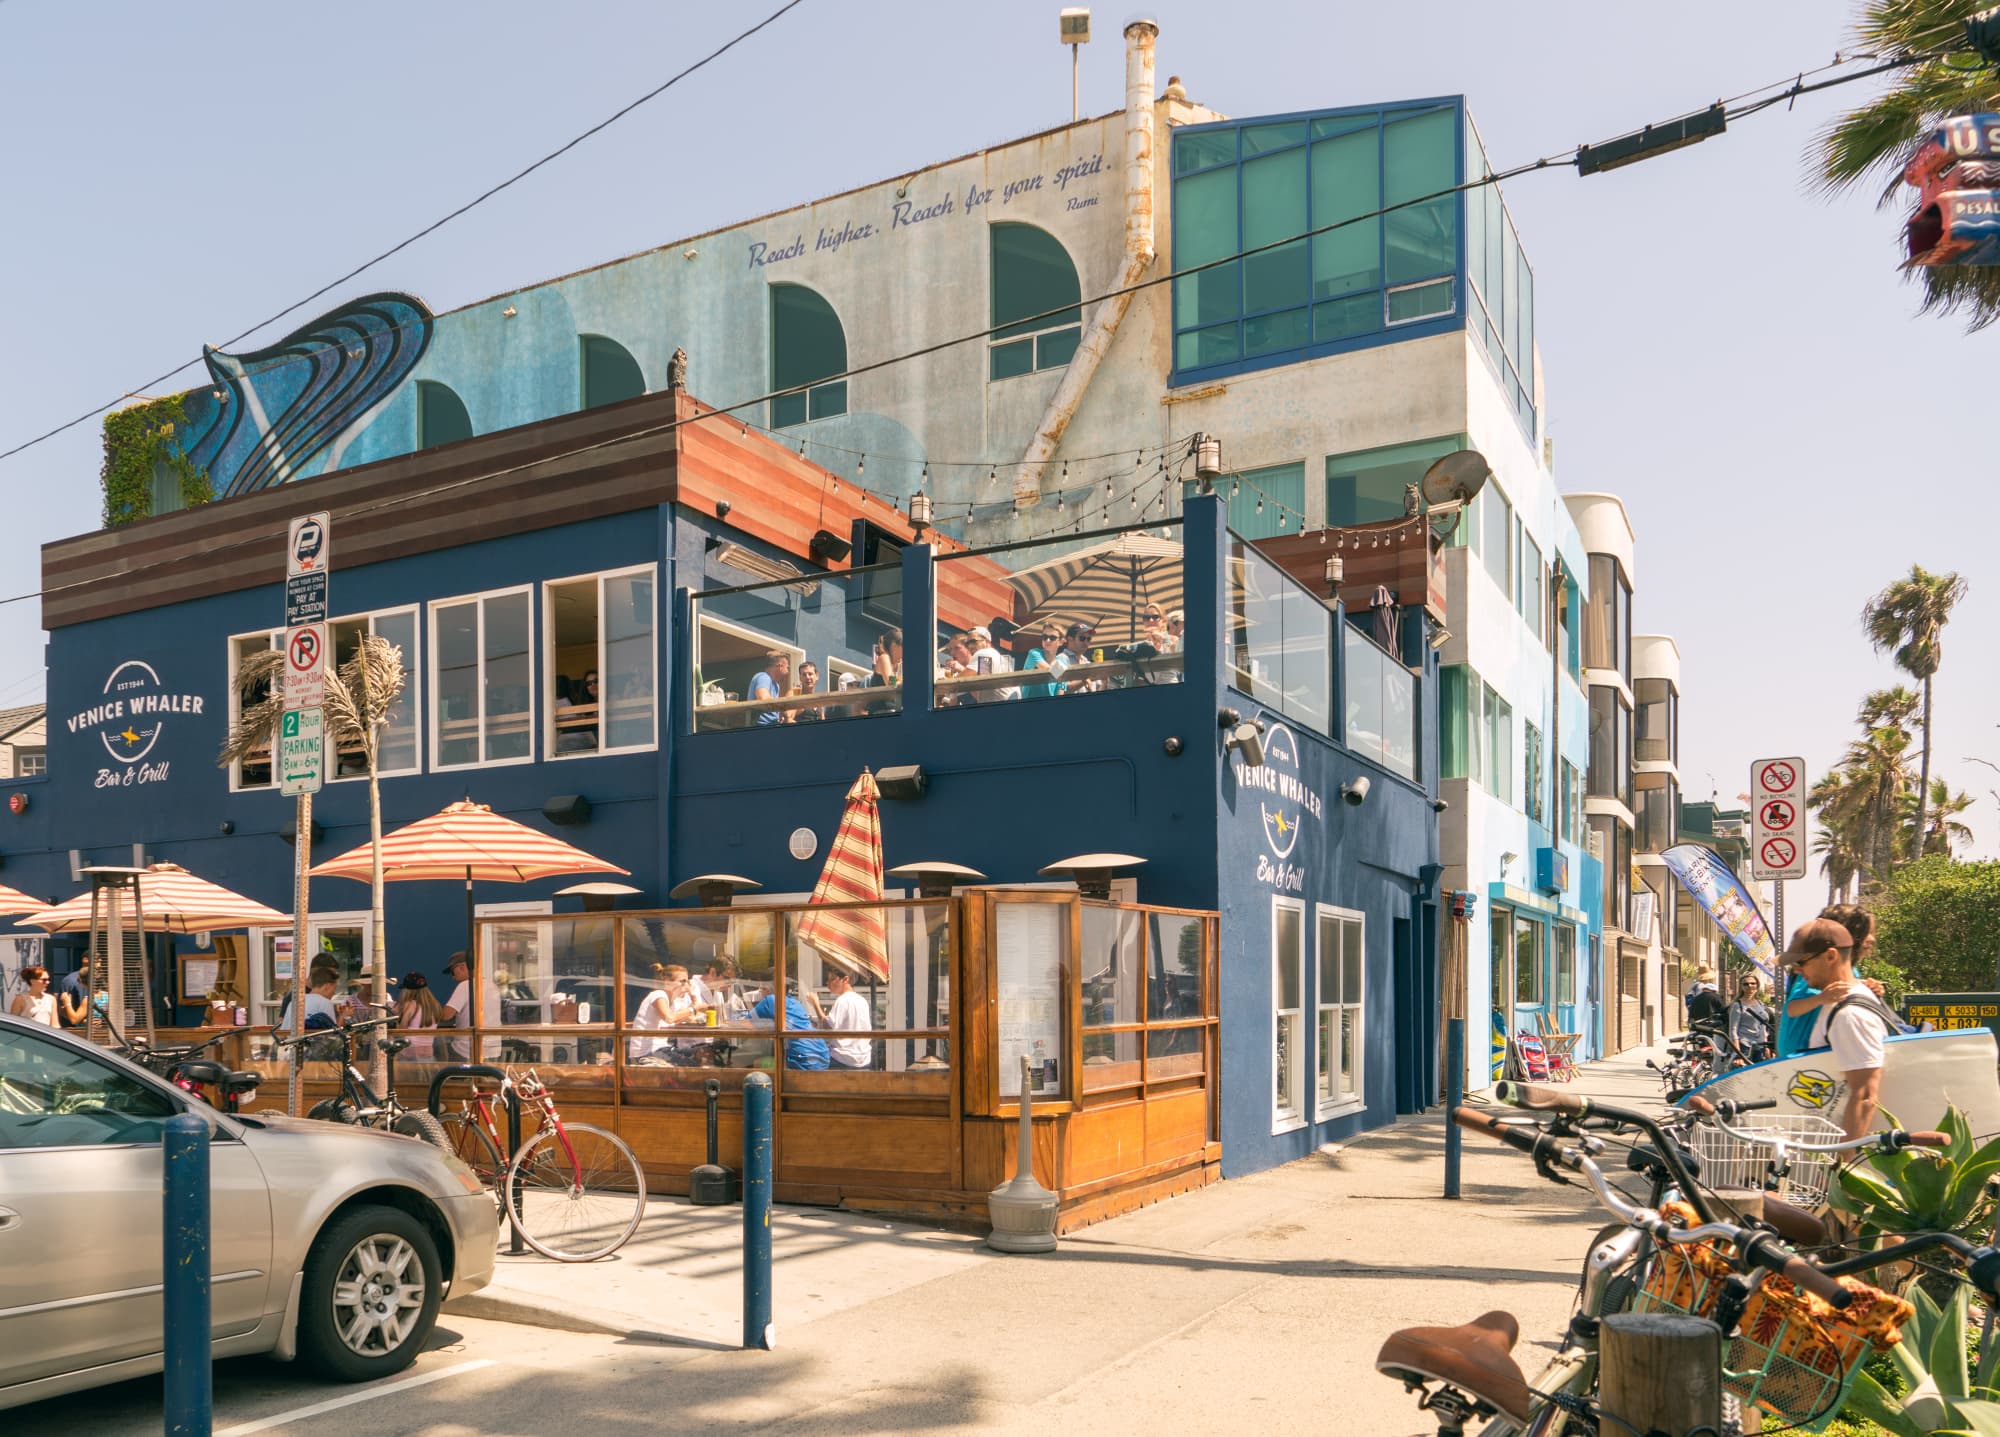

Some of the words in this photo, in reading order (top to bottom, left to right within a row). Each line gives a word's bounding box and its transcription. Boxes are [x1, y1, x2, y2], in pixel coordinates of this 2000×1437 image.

[748, 234, 806, 270] Reach
[815, 220, 880, 253] higher.
[892, 191, 953, 230] Reach
[965, 184, 994, 215] for
[1003, 174, 1044, 204] your
[1053, 153, 1111, 191] spirit.
[1066, 193, 1099, 212] Rumi
[296, 594, 307, 604] PAY
[309, 591, 317, 601] AT
[288, 606, 299, 617] PAY
[300, 601, 325, 614] STATION
[117, 682, 129, 691] EST
[129, 679, 145, 689] 1944
[67, 701, 124, 733] VENICE
[130, 694, 204, 714] WHALER
[286, 715, 295, 734] 2
[300, 715, 320, 728] HOUR
[284, 737, 320, 755] PARKING
[1272, 746, 1280, 758] EST
[95, 768, 121, 788] Bar
[123, 766, 135, 786] &
[137, 761, 170, 784] Grill
[1236, 763, 1276, 792] VENICE
[1279, 772, 1321, 820] WHALER
[1256, 854, 1274, 884] Bar
[1275, 863, 1285, 889] &
[1285, 864, 1305, 892] Grill
[1945, 1006, 1952, 1015] K
[1955, 1006, 1977, 1015] 5033
[1982, 1006, 1996, 1015] 150
